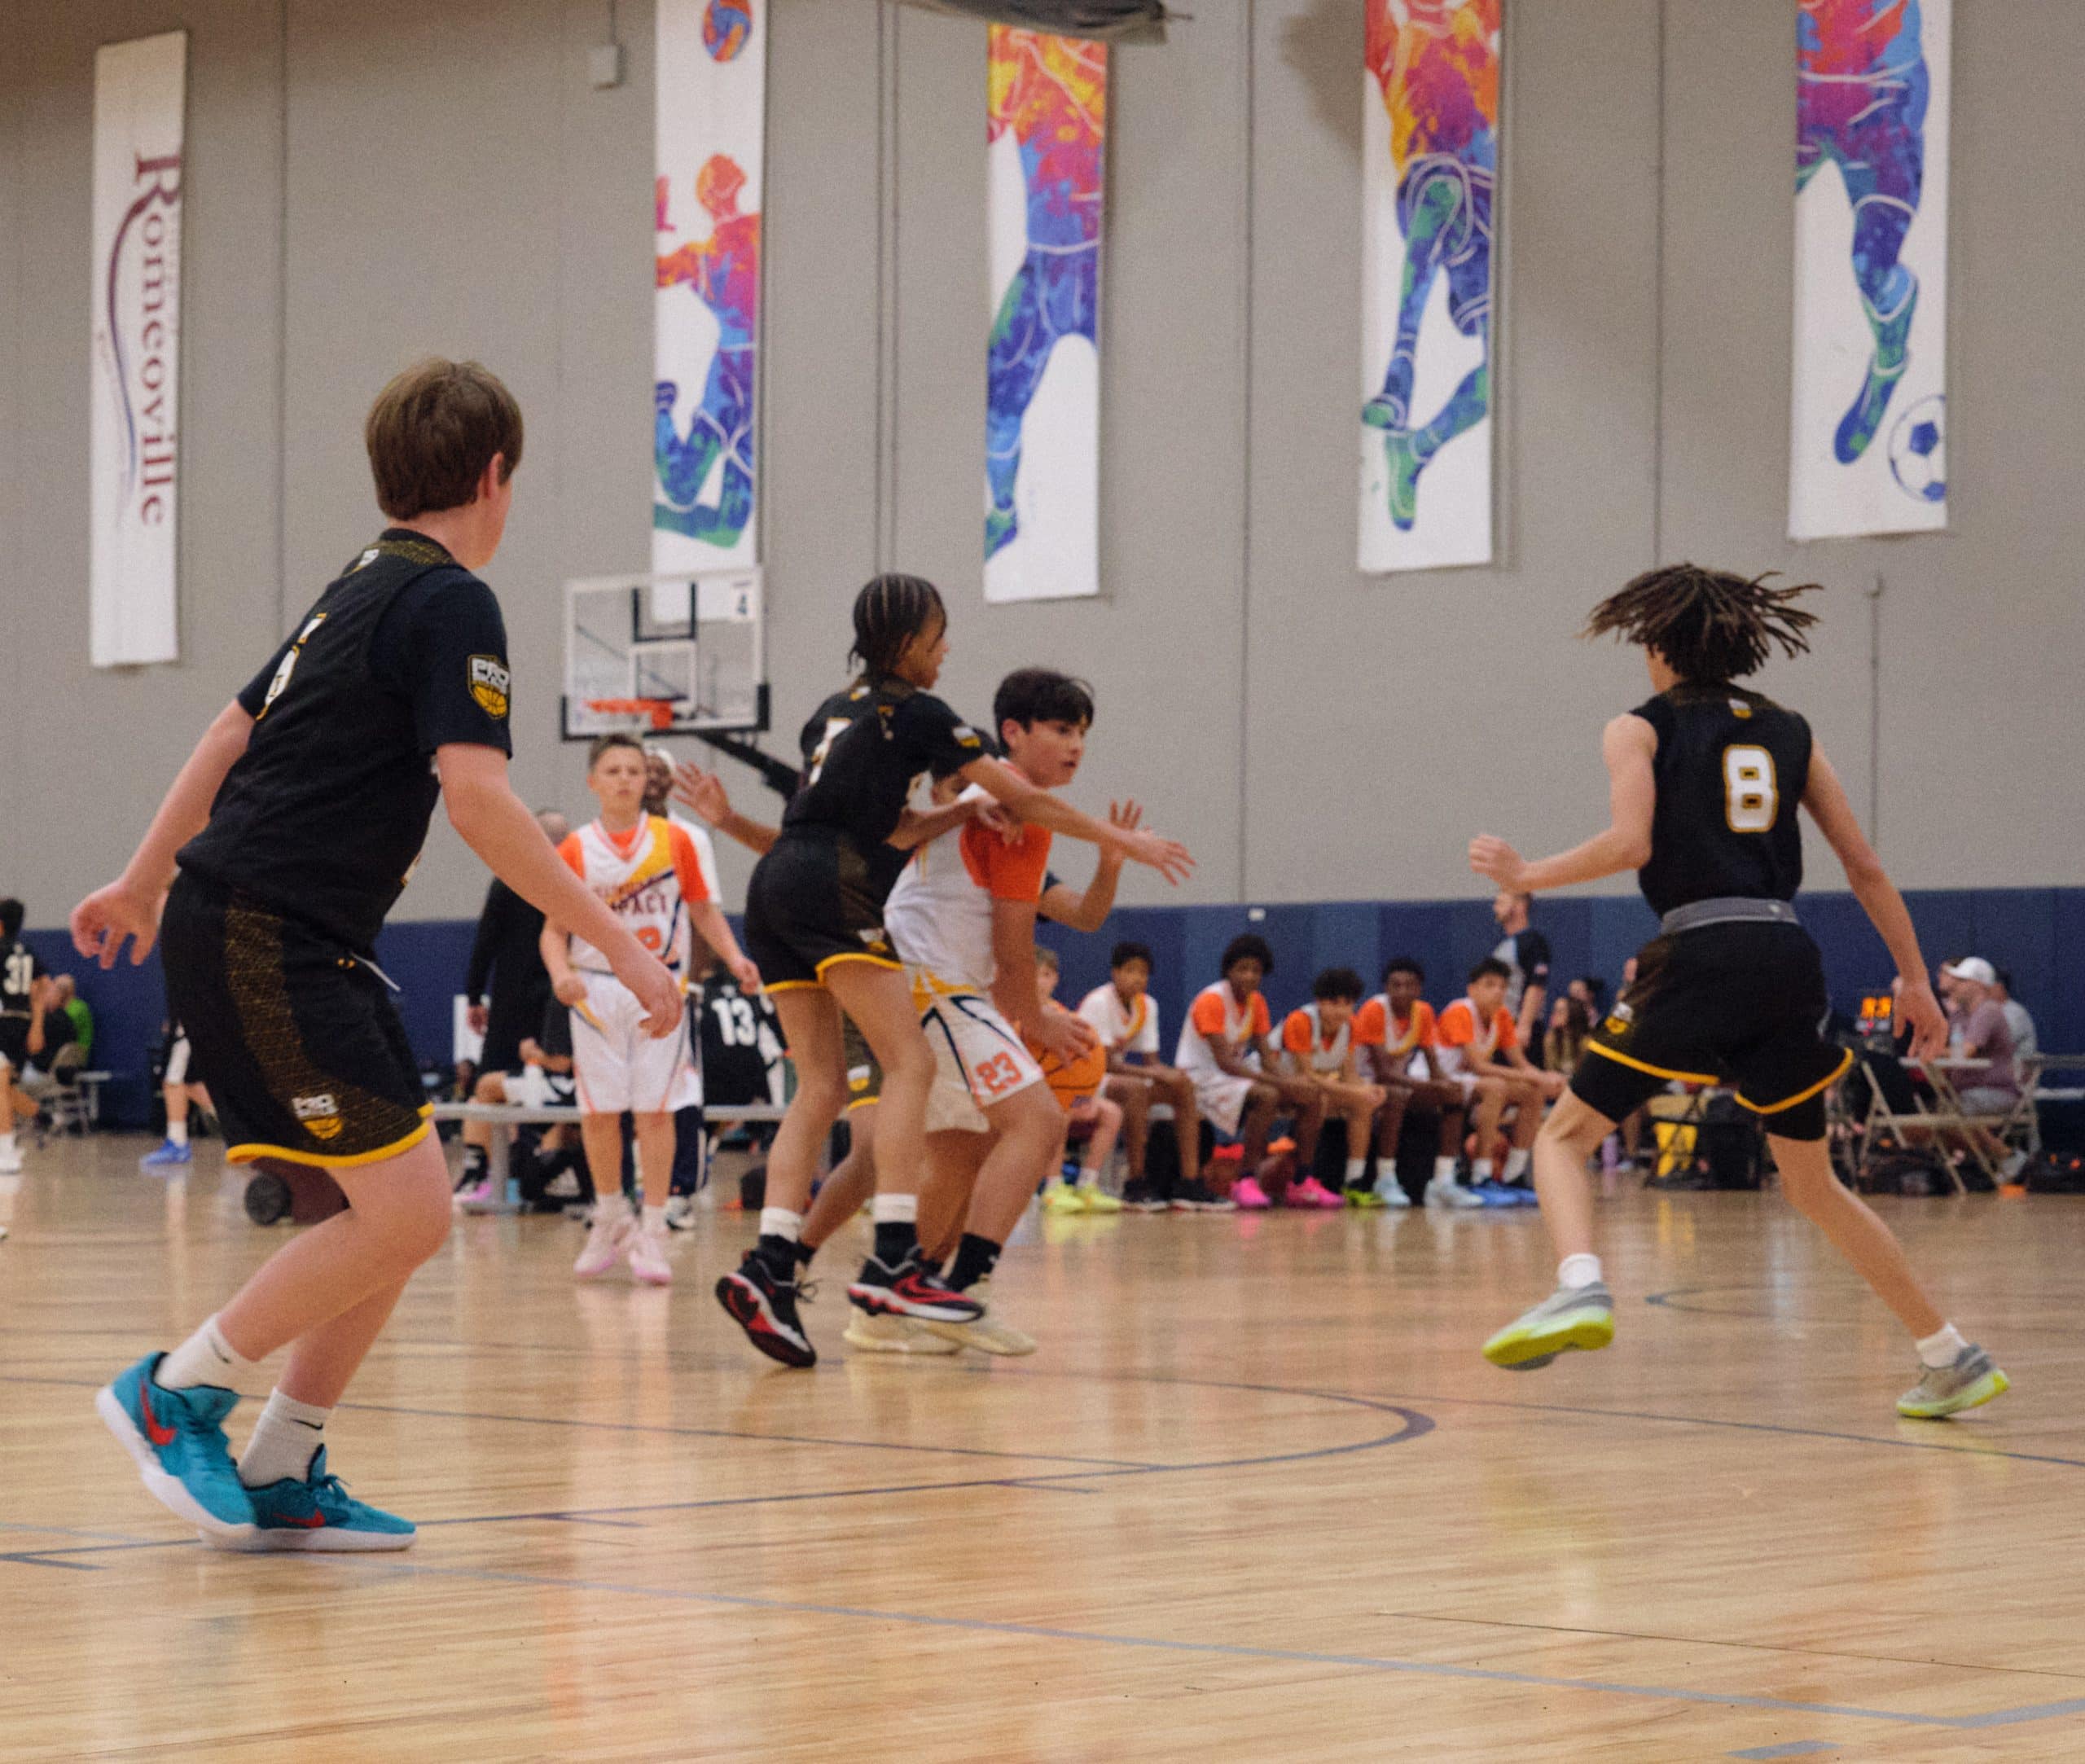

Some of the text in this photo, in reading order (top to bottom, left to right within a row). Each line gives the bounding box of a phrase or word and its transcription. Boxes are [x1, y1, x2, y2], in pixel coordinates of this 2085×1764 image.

[124, 150, 182, 525] Romeoville
[1722, 744, 1780, 833] 8
[3, 953, 33, 995] 31
[710, 998, 757, 1046] 13
[975, 1051, 1022, 1095] 23
